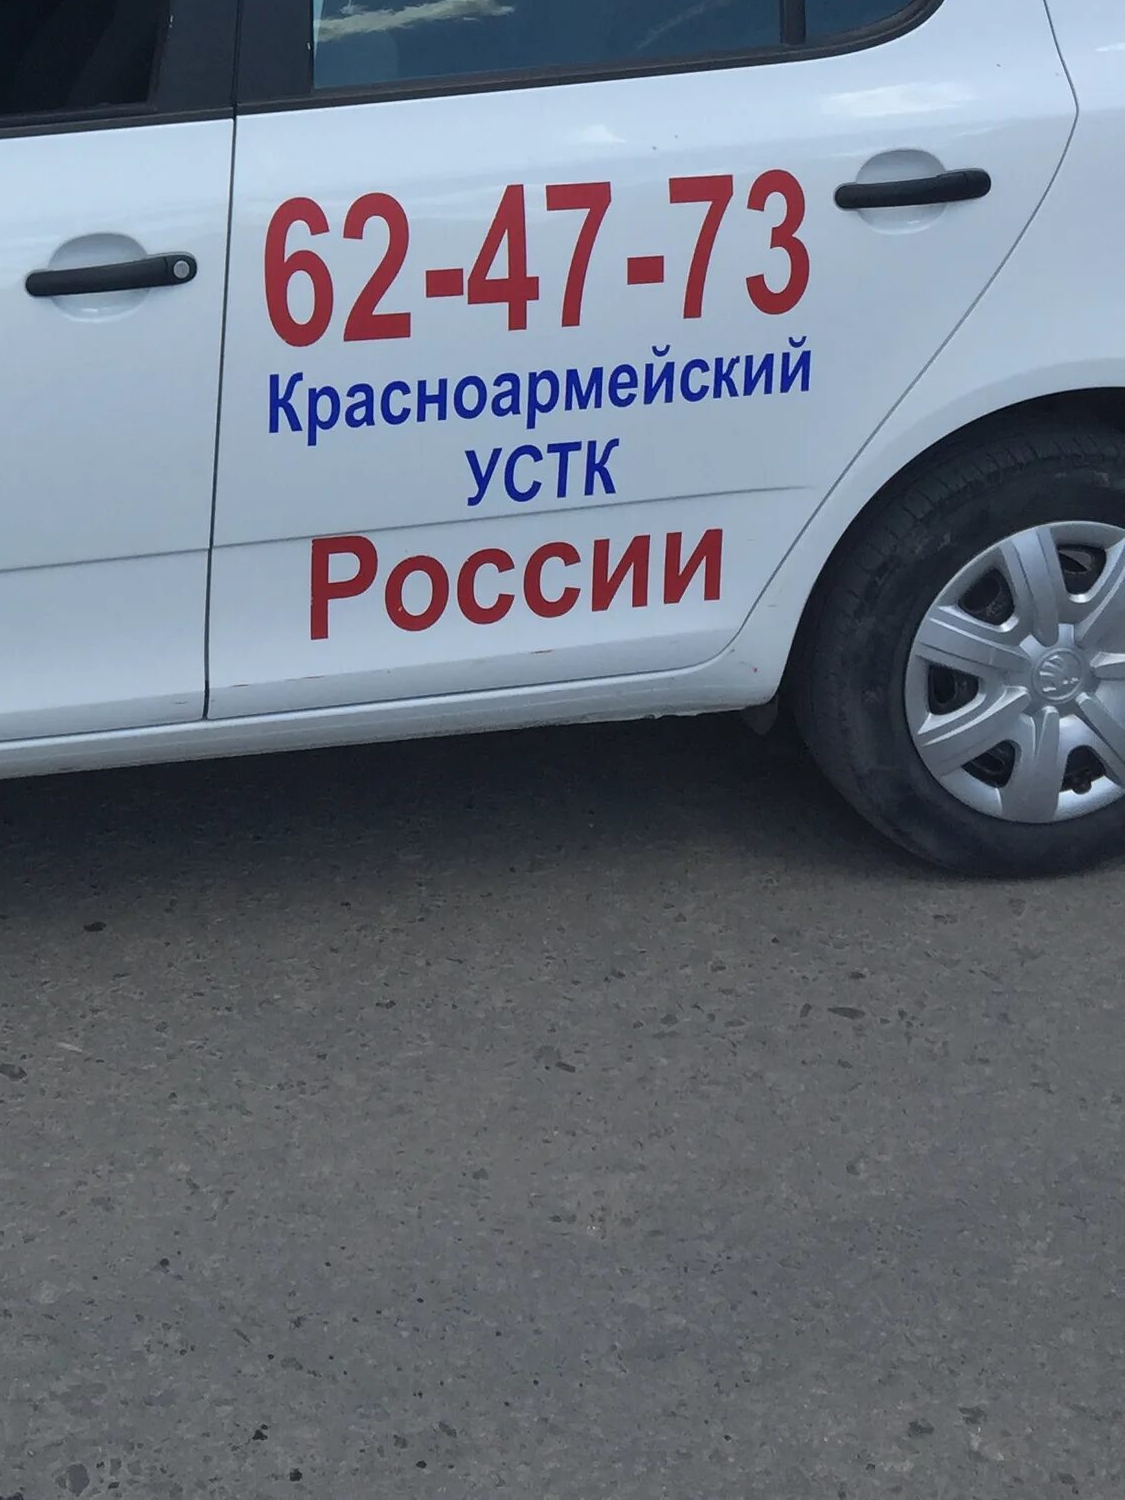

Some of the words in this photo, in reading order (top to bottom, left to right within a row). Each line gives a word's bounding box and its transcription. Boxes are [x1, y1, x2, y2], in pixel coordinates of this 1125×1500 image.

[264, 169, 810, 348] 62-47-73
[268, 336, 812, 446] Красноармейский
[465, 438, 619, 506] УСТК
[309, 528, 723, 640] России
